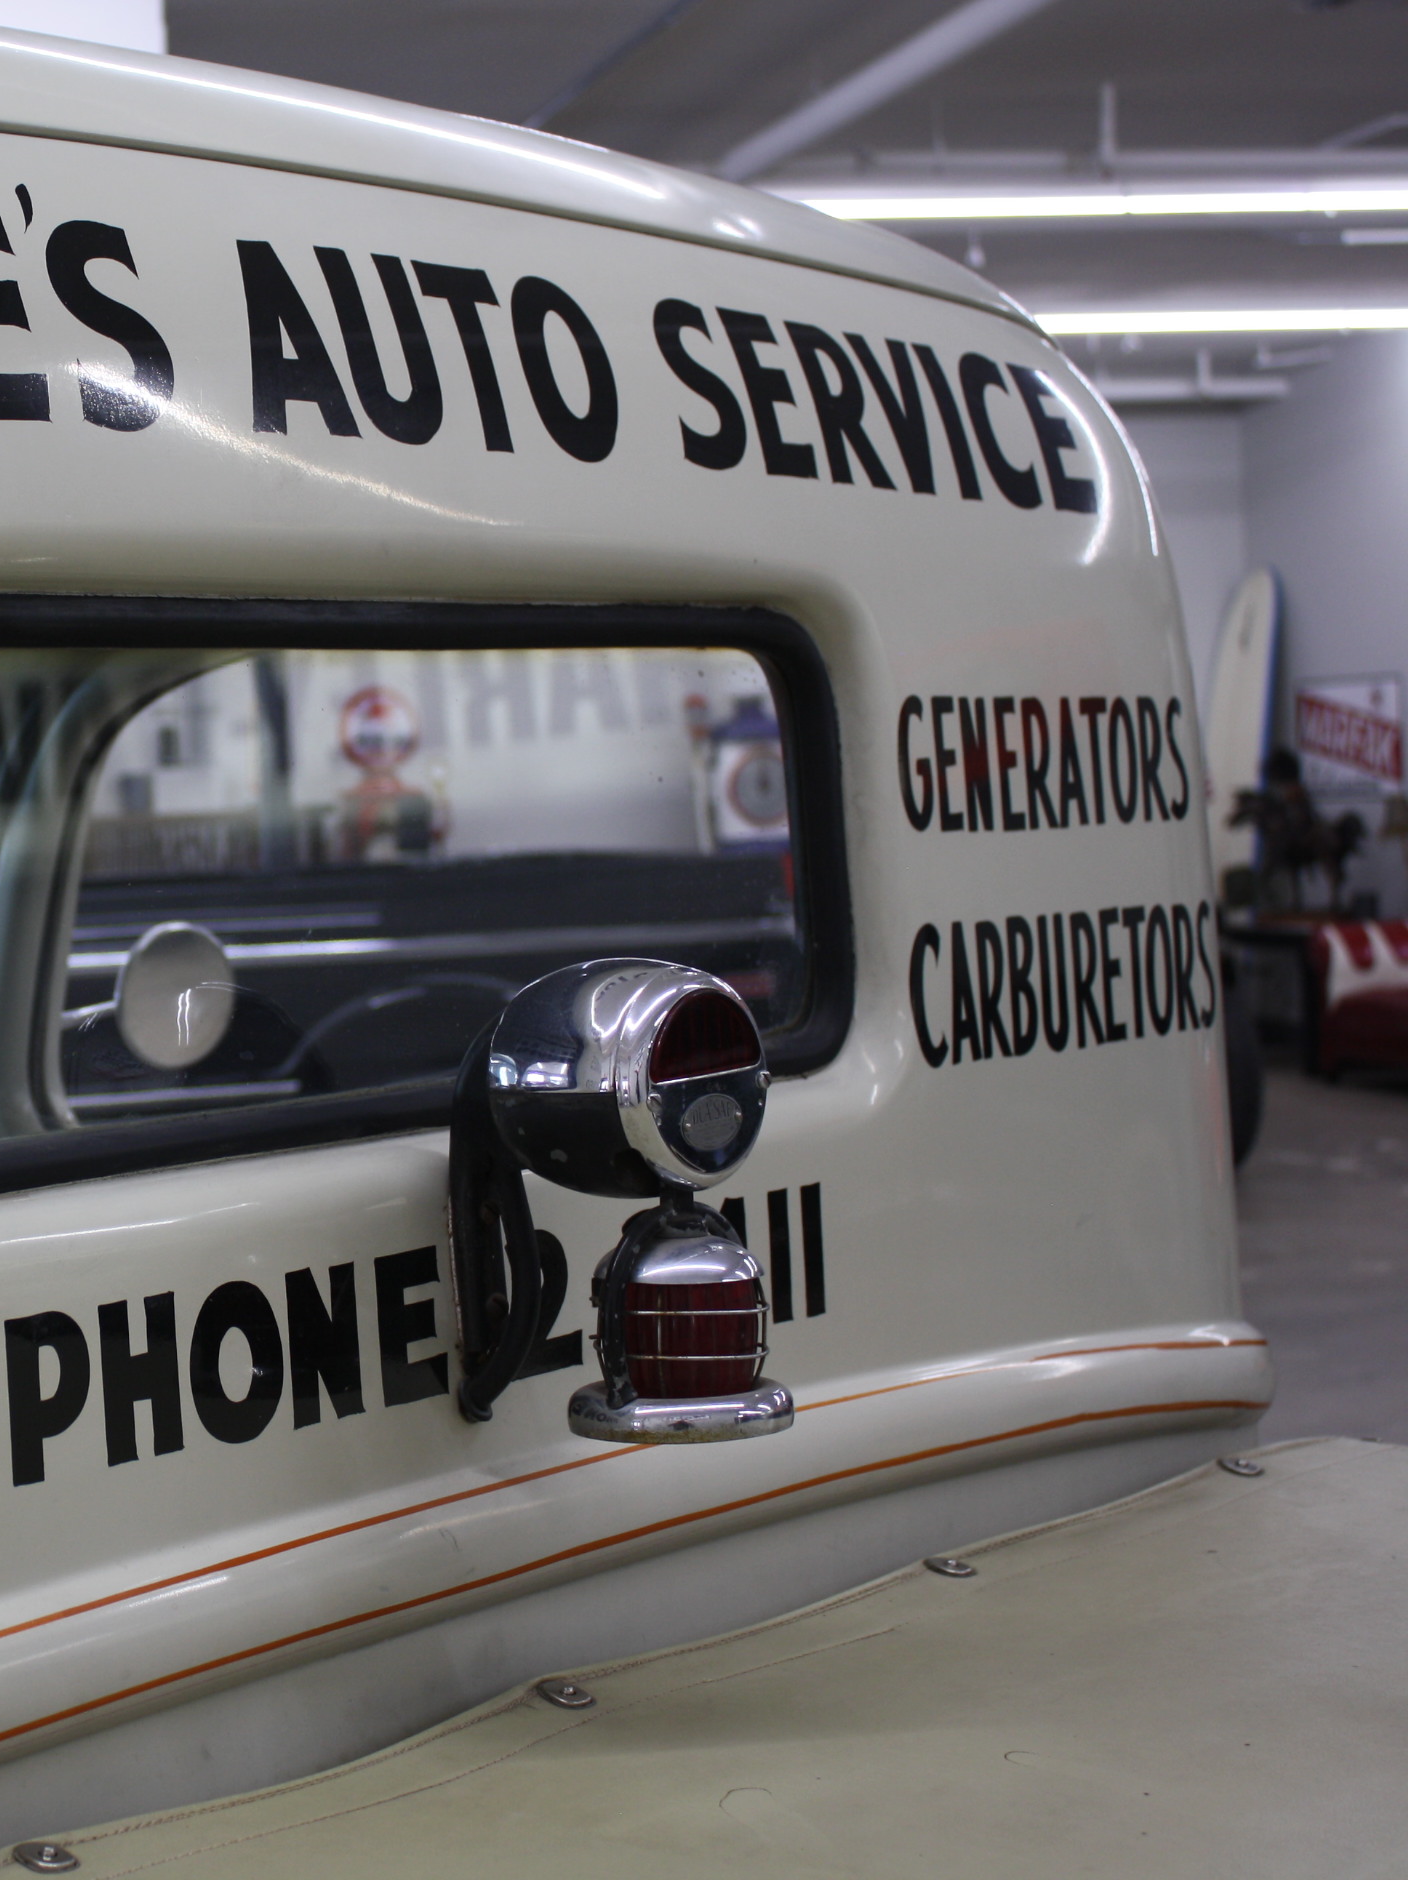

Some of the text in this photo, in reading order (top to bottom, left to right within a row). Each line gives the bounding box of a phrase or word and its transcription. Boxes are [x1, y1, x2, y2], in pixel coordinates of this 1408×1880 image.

[237, 239, 619, 463] AUTO
[654, 298, 1098, 514] SERVICE
[897, 694, 1190, 833] GENERATORS
[908, 900, 1218, 1069] CARBURETORS
[3, 1244, 450, 1488] PHONE
